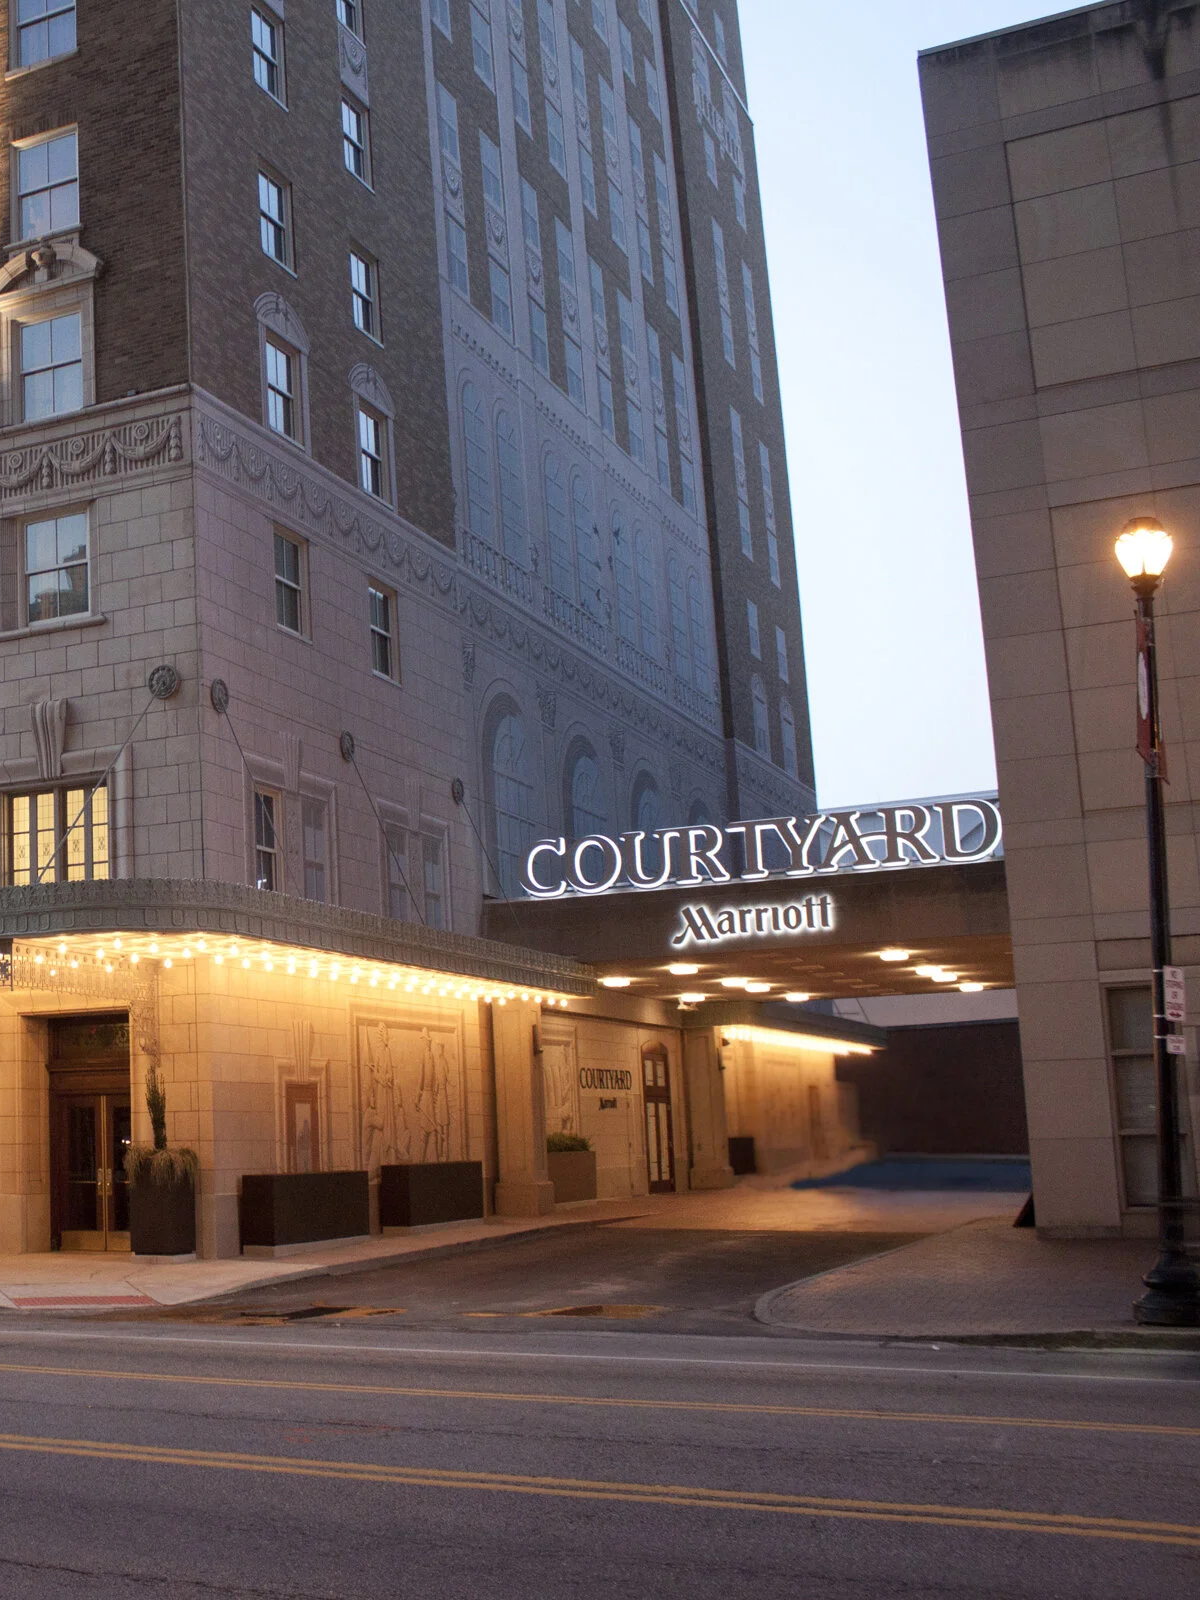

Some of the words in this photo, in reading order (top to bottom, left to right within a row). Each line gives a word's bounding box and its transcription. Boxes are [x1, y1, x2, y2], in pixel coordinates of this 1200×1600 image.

[519, 798, 1004, 898] COURTYARD
[672, 894, 834, 946] Marriott
[580, 1067, 632, 1090] COURTYARD
